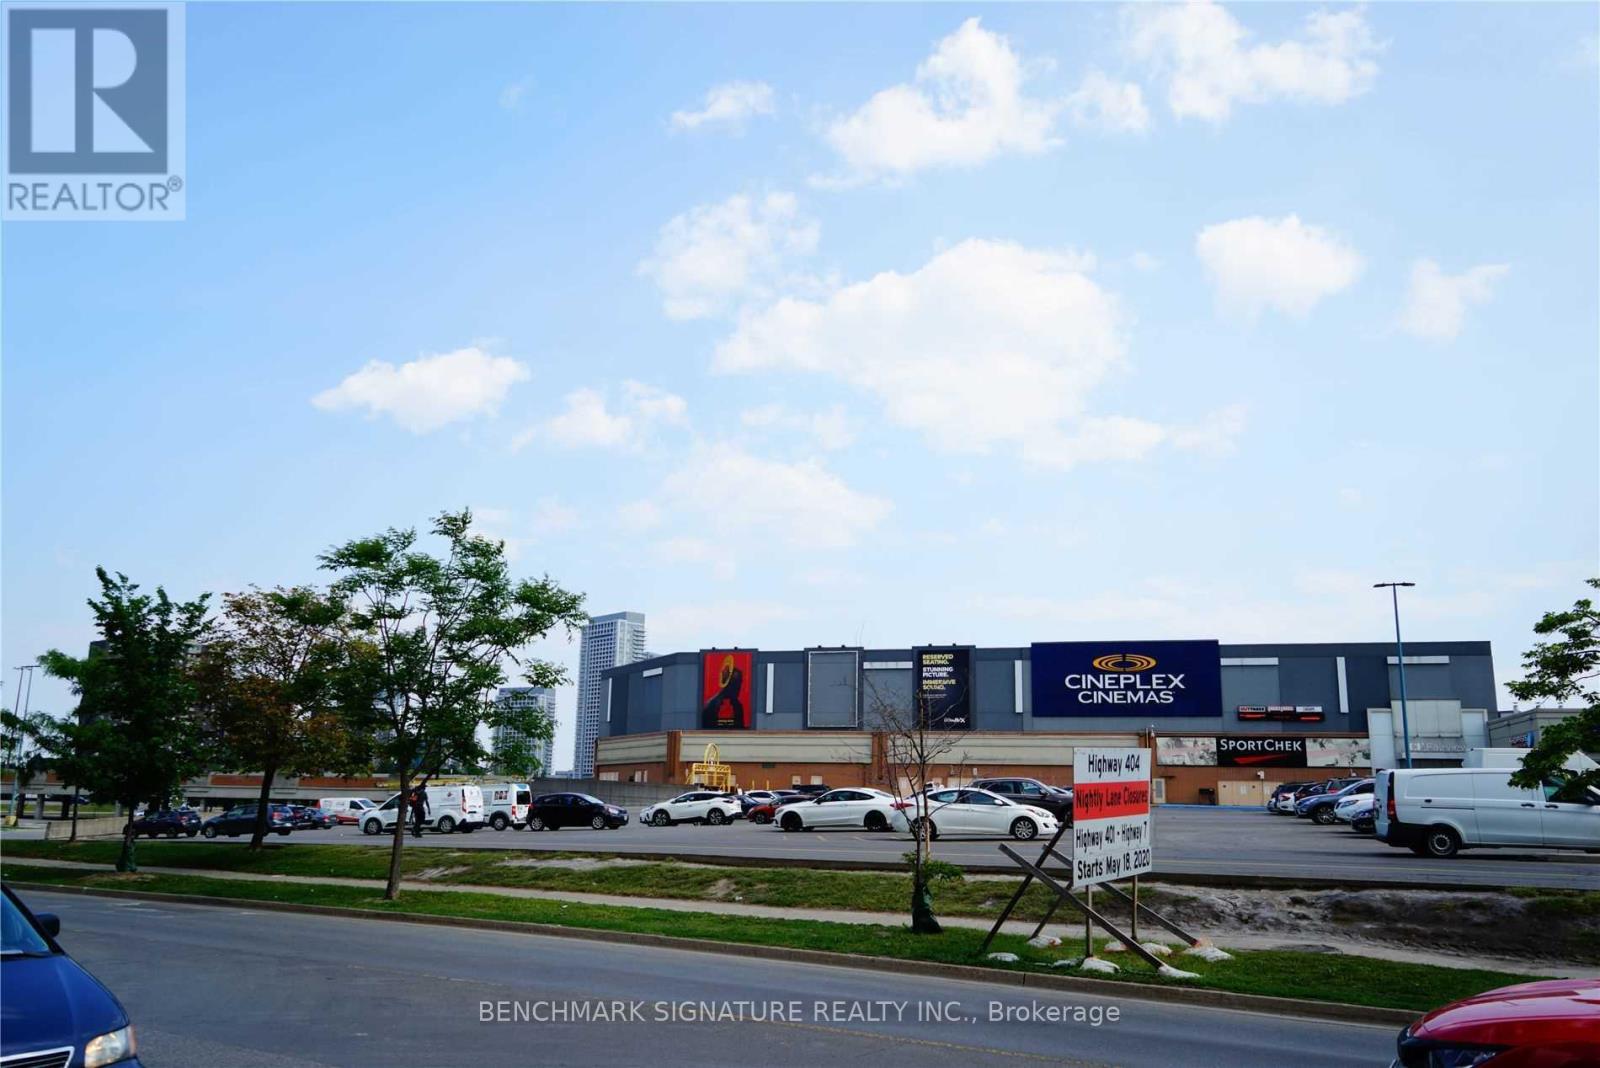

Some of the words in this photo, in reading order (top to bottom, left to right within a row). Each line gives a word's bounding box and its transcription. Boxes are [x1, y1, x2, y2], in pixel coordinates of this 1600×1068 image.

[1064, 674, 1186, 689] CINEPLEX
[1077, 690, 1175, 704] CINEMAS
[1088, 753, 1122, 779] Highway
[1125, 754, 1140, 773] 404
[1076, 788, 1103, 812] Nightly
[1105, 787, 1121, 807] Lane
[1123, 785, 1149, 805] Closures
[1076, 828, 1103, 853] Highway
[1105, 825, 1115, 844] 401
[1121, 823, 1142, 846] Highway
[1077, 860, 1103, 880] Starts
[1106, 856, 1120, 877] May
[1123, 852, 1132, 872] 18,
[1134, 848, 1150, 869] 2020
